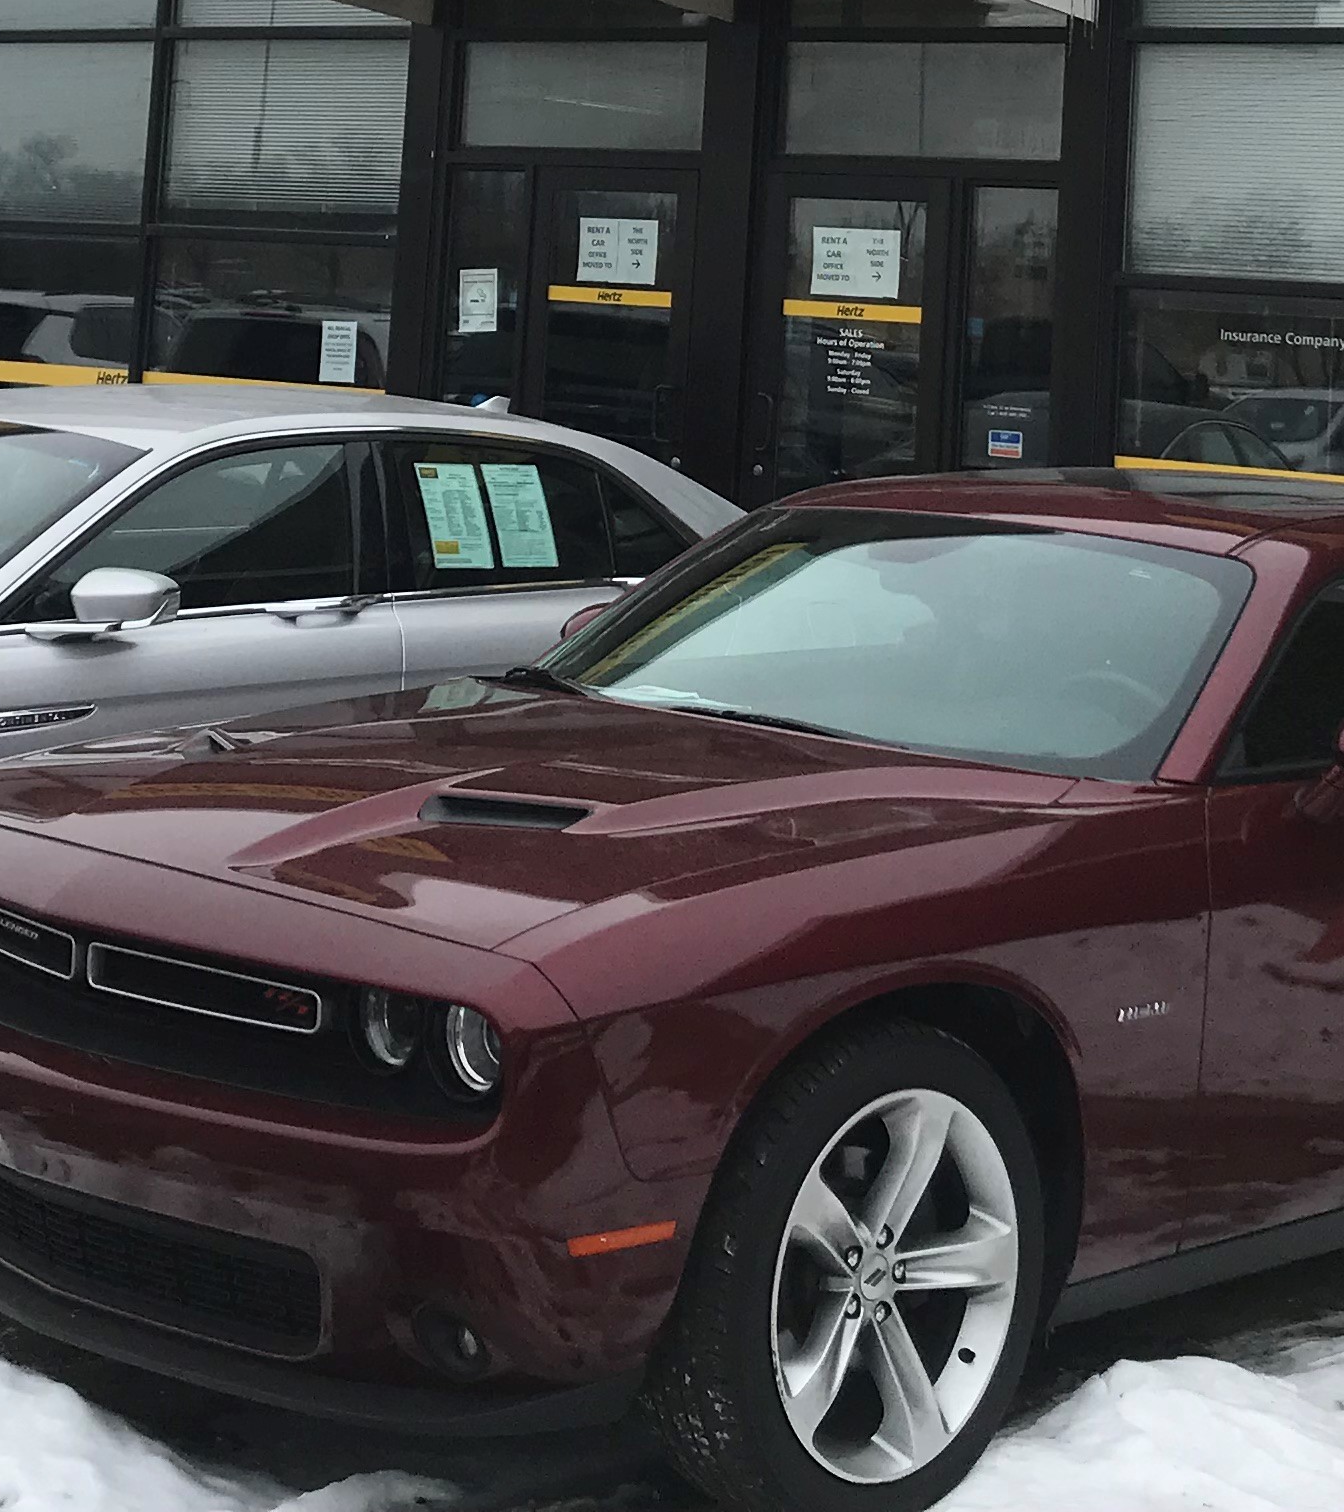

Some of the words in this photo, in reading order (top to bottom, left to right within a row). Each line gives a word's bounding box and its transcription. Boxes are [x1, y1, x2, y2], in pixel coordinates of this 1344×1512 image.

[587, 226, 604, 235] RENT
[821, 236, 841, 245] RENT
[826, 250, 842, 258] CAR
[870, 260, 884, 268] SIDE
[816, 273, 840, 281] MOVED
[597, 291, 623, 302] Hertz
[836, 305, 865, 317] Hertz
[839, 328, 863, 338] SALES
[1220, 328, 1282, 344] Insurance
[816, 336, 837, 346] Hours
[838, 338, 847, 346] of
[848, 338, 885, 349] Operation
[96, 370, 128, 385] Hertz
